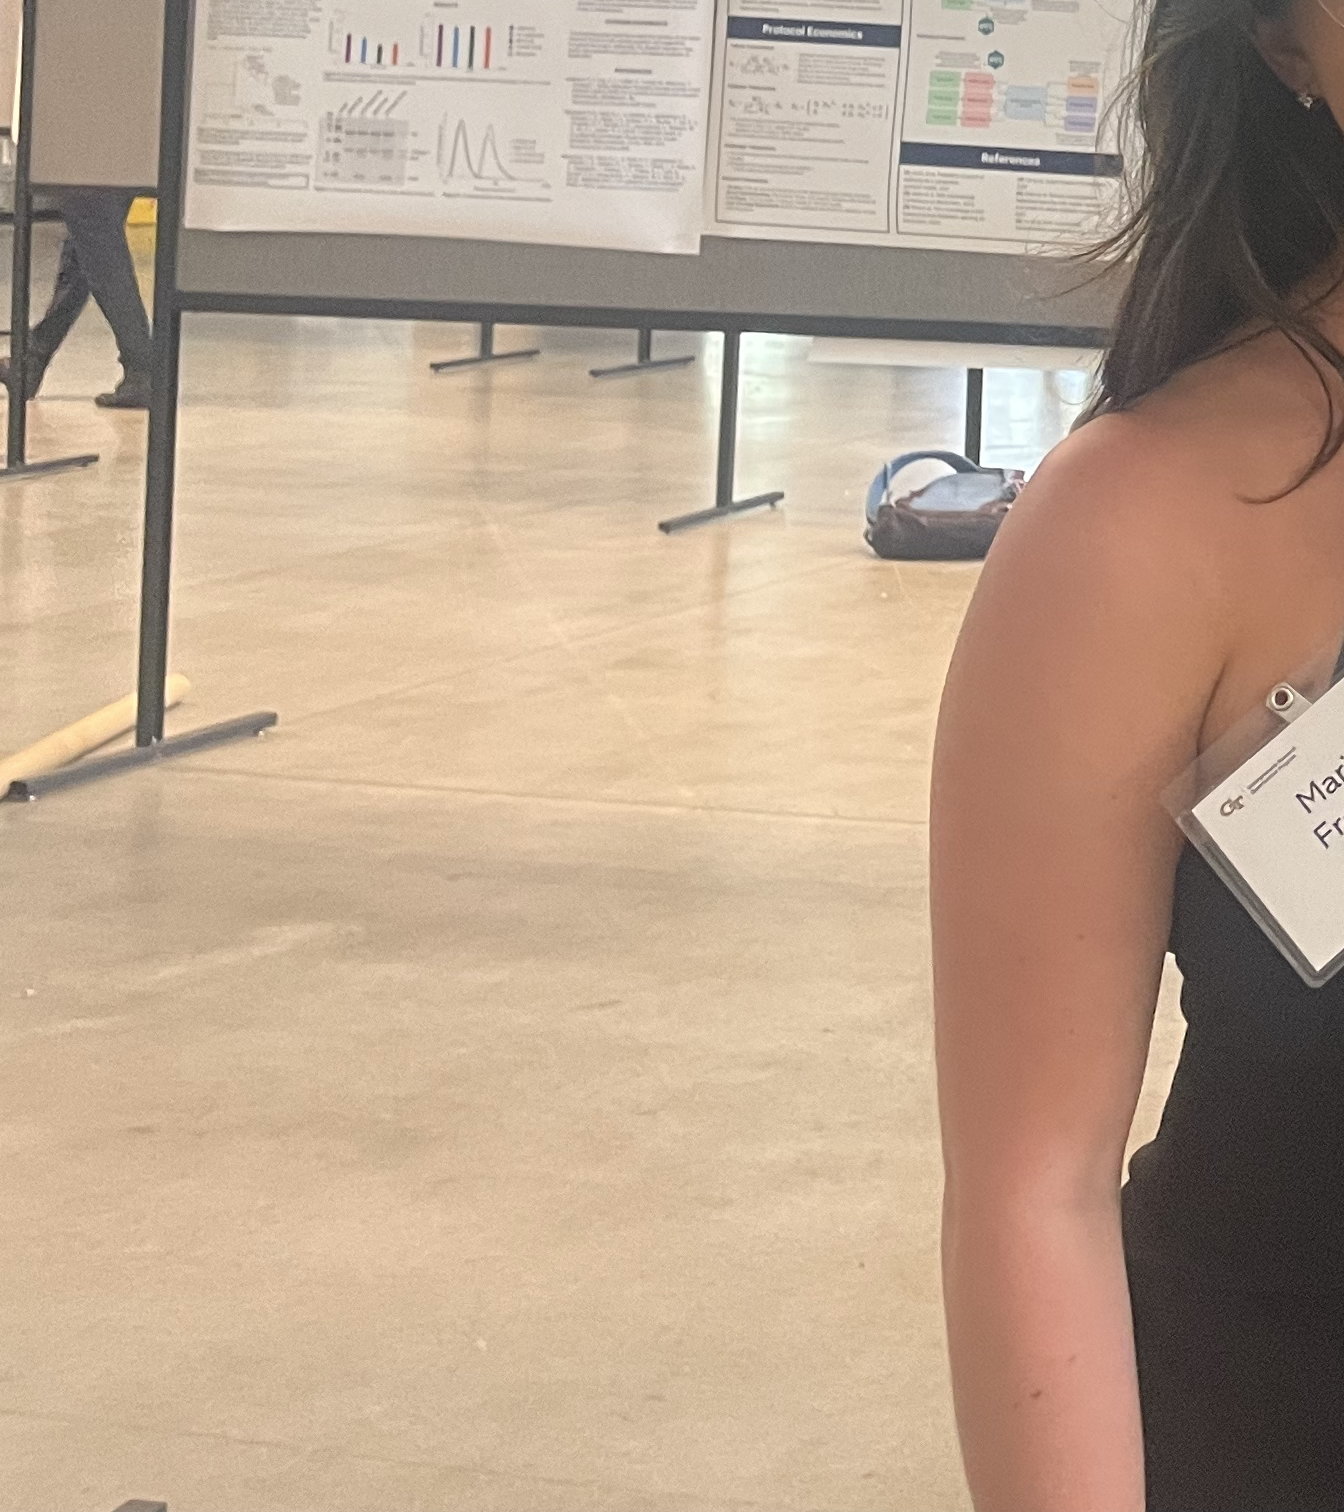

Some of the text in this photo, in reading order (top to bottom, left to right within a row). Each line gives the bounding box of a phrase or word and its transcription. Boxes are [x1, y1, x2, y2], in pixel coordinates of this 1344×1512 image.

[762, 23, 863, 40] Protocol Economics
[980, 152, 1041, 167] References
